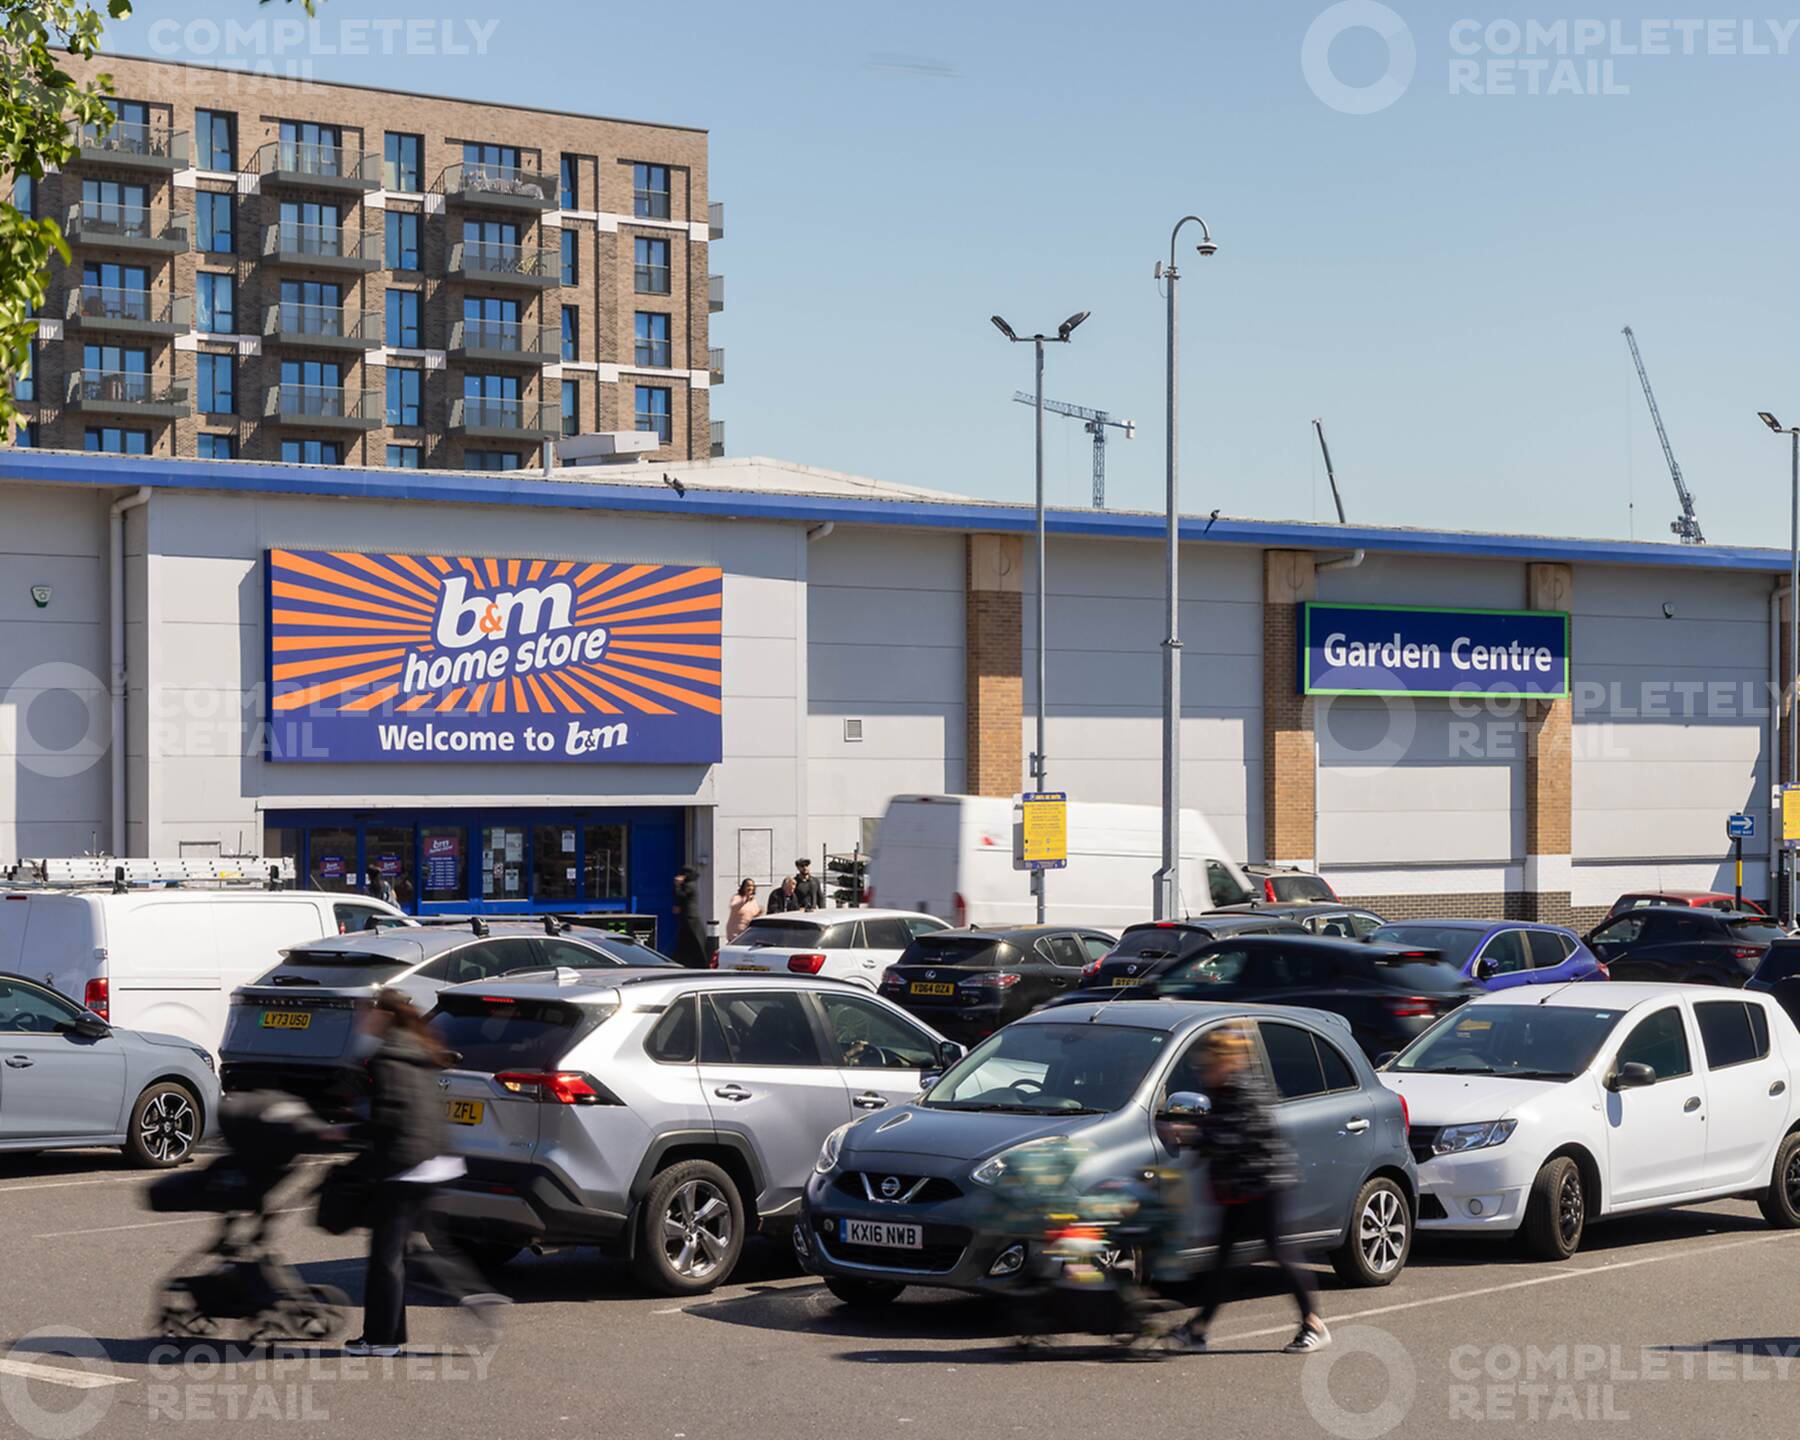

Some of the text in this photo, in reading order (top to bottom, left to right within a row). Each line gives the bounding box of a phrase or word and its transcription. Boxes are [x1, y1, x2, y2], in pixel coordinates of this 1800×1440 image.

[437, 576, 575, 648] b&m
[403, 628, 607, 693] home store
[1324, 632, 1552, 672] Garden Centre
[378, 721, 628, 755] Welcome to b&m
[264, 1012, 289, 1025] LY73
[453, 1102, 476, 1120] ZFL
[851, 1223, 916, 1245] KX16 NWB
